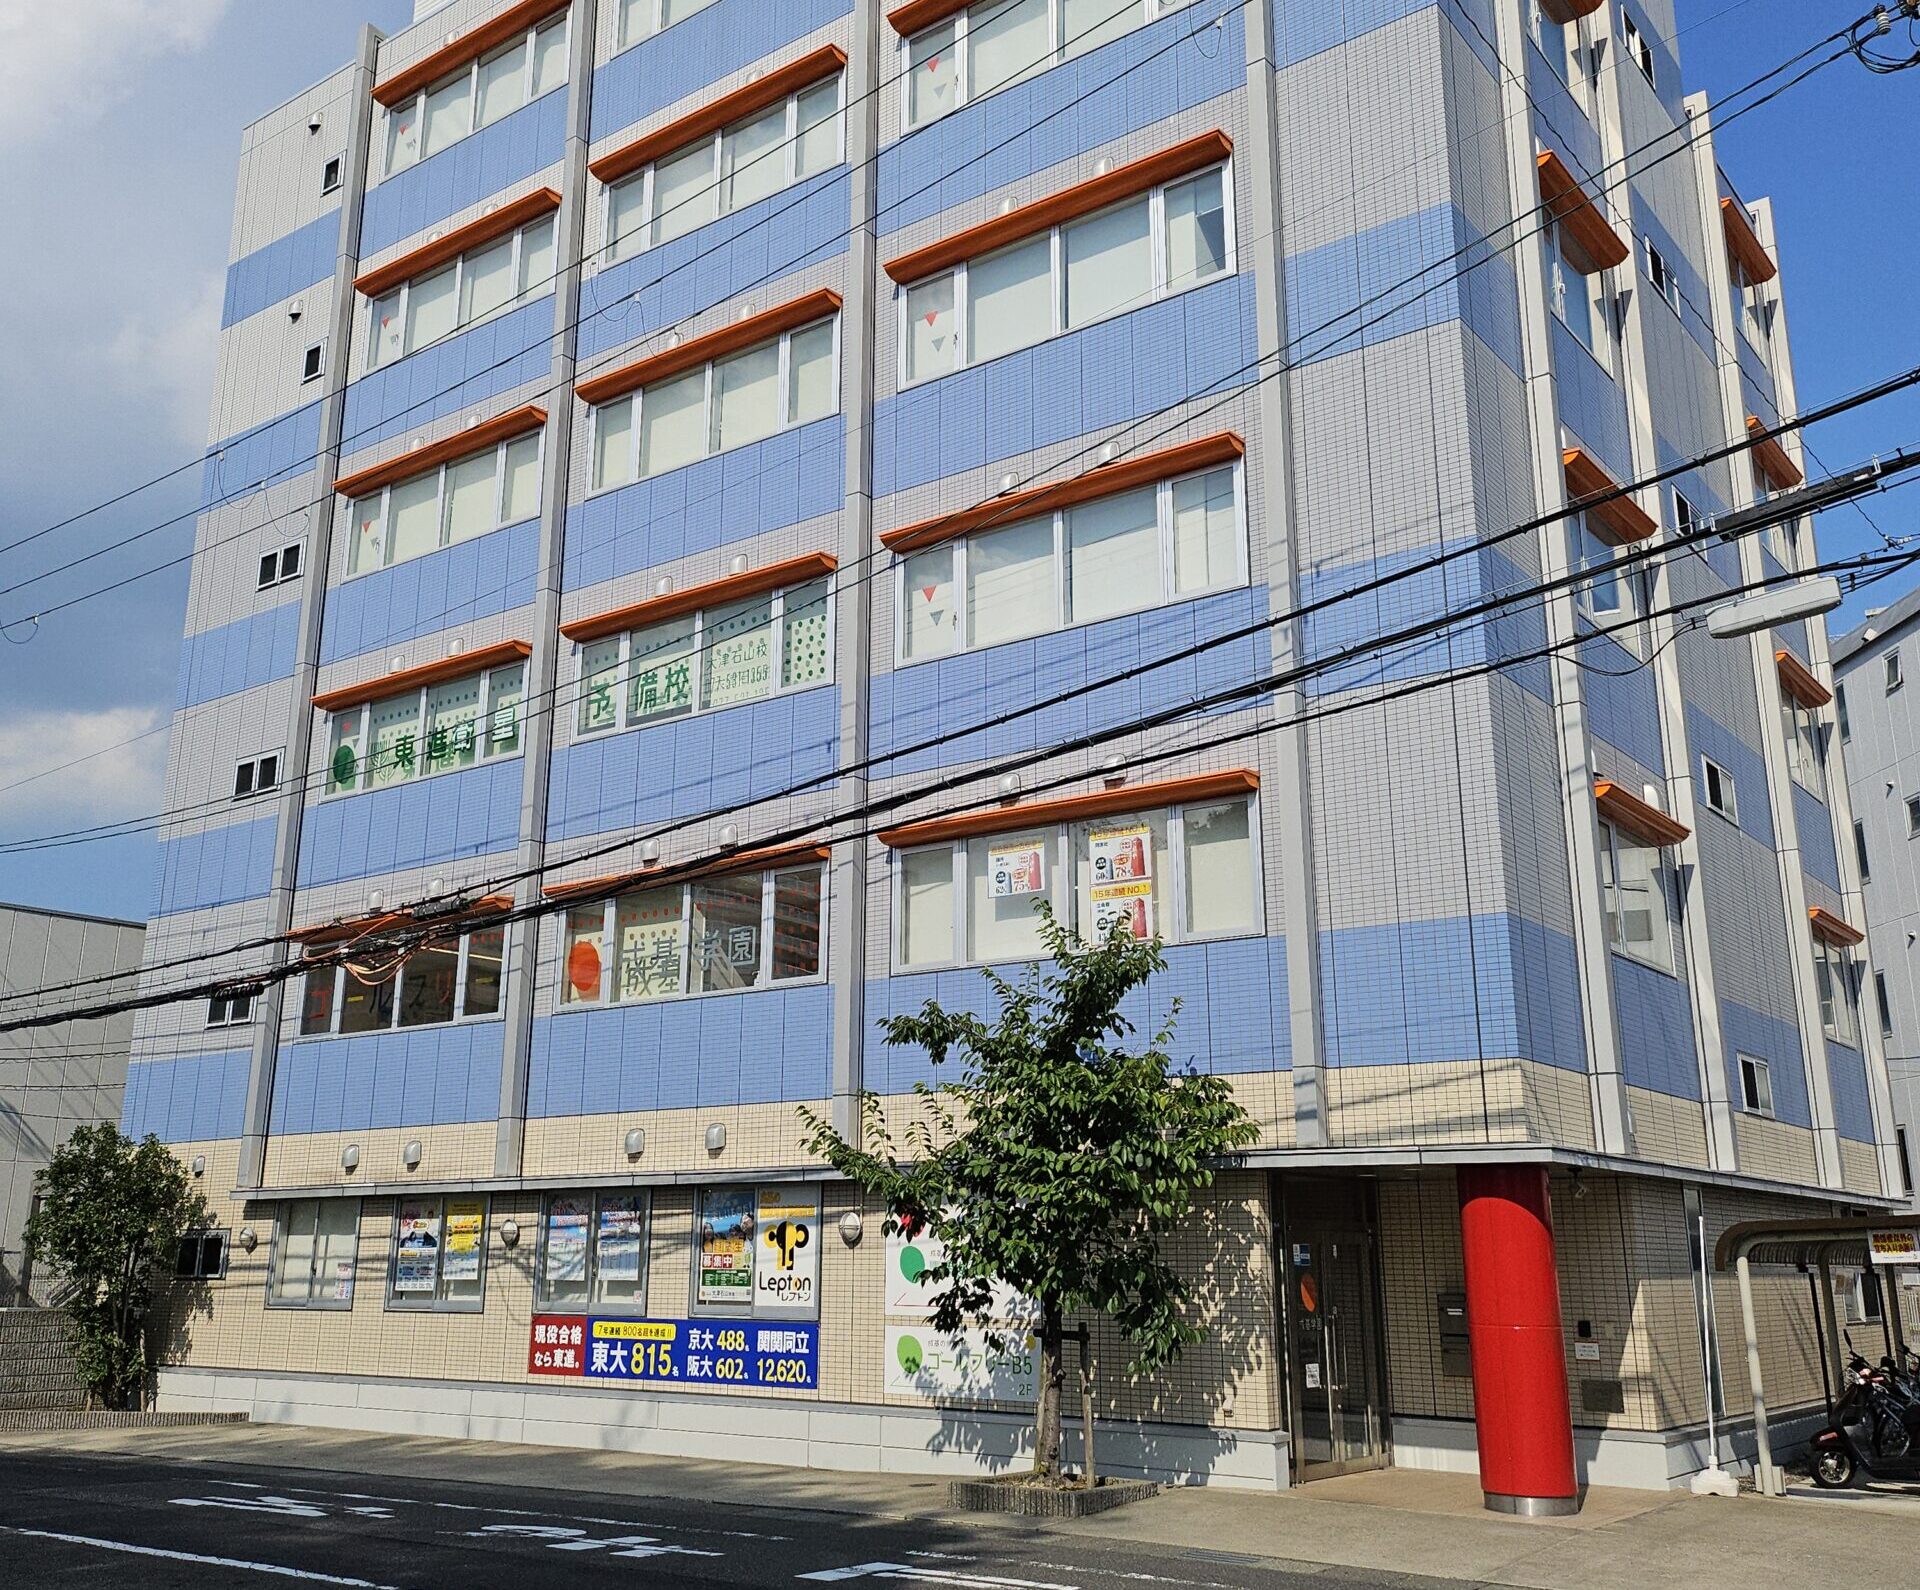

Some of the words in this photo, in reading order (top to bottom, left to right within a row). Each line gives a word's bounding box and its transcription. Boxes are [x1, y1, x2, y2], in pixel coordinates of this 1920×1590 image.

[588, 664, 690, 720] 予備校
[393, 706, 515, 770] 東進衛星
[760, 1271, 811, 1297] Lepton
[535, 1325, 583, 1345] 現役合格
[756, 1330, 810, 1354] 関関同立
[1018, 1383, 1033, 1396] 2F
